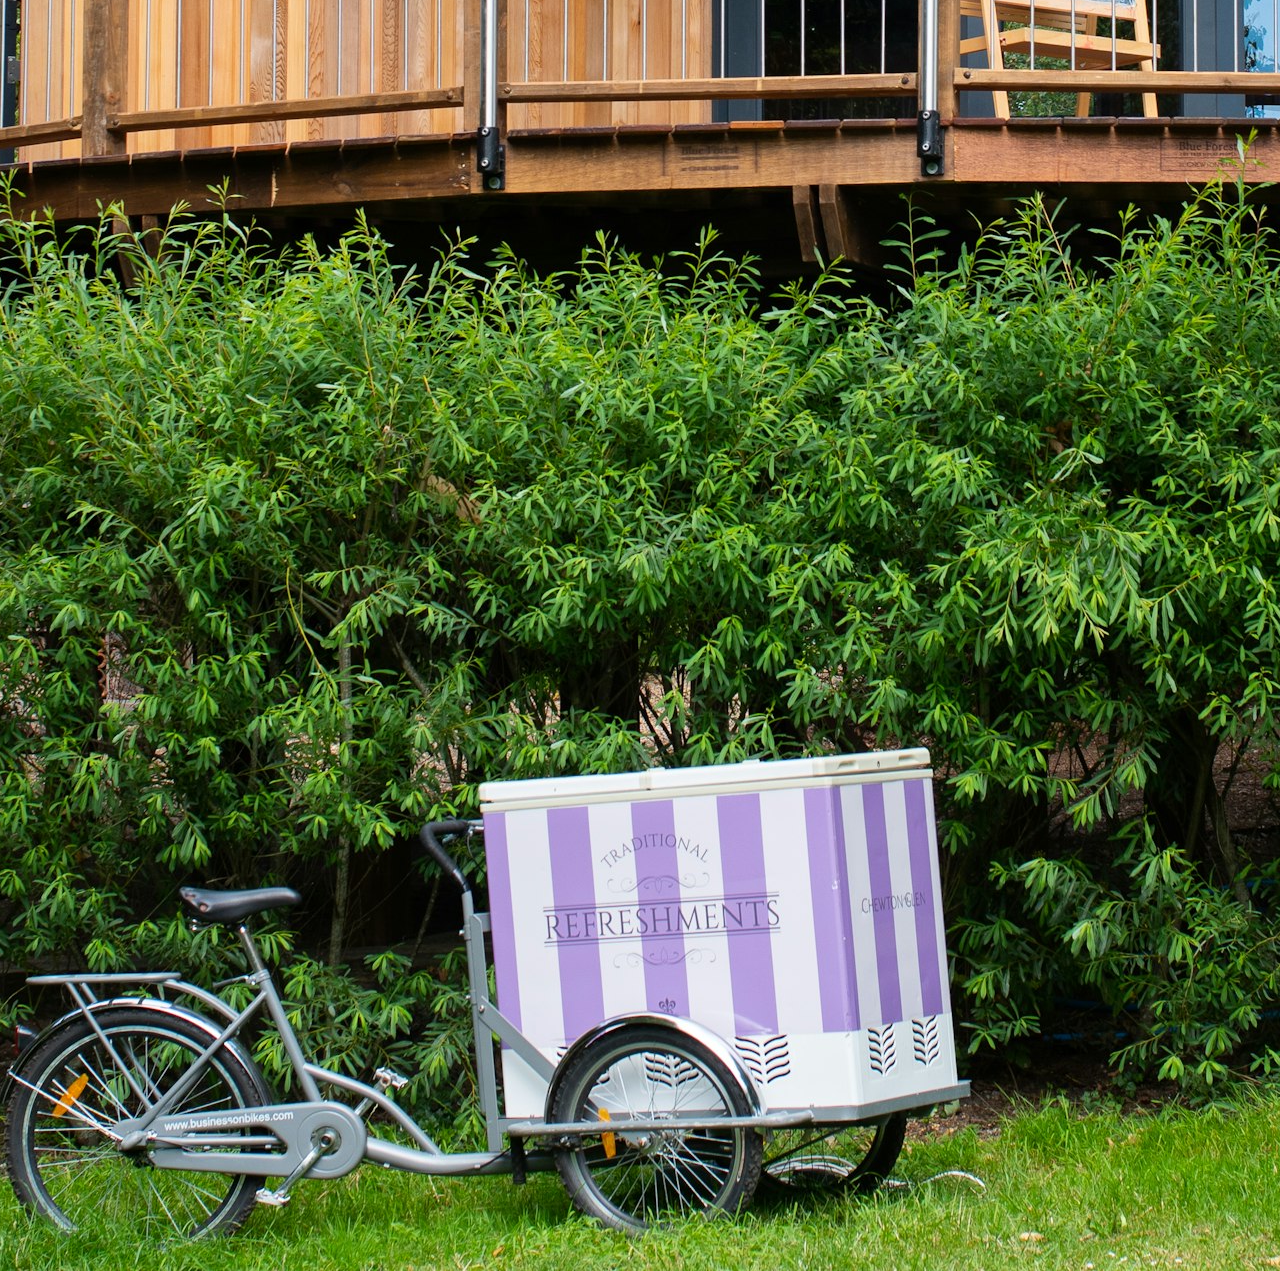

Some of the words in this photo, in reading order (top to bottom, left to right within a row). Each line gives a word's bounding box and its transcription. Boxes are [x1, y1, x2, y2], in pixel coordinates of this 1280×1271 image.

[1179, 141, 1202, 151] Blue
[600, 833, 709, 869] TRADITIONAL
[861, 895, 904, 914] CHEWTON
[904, 892, 927, 908] GLEN
[545, 899, 781, 940] REFRESHMENTS
[164, 1111, 294, 1131] www.businessonbikes.com
